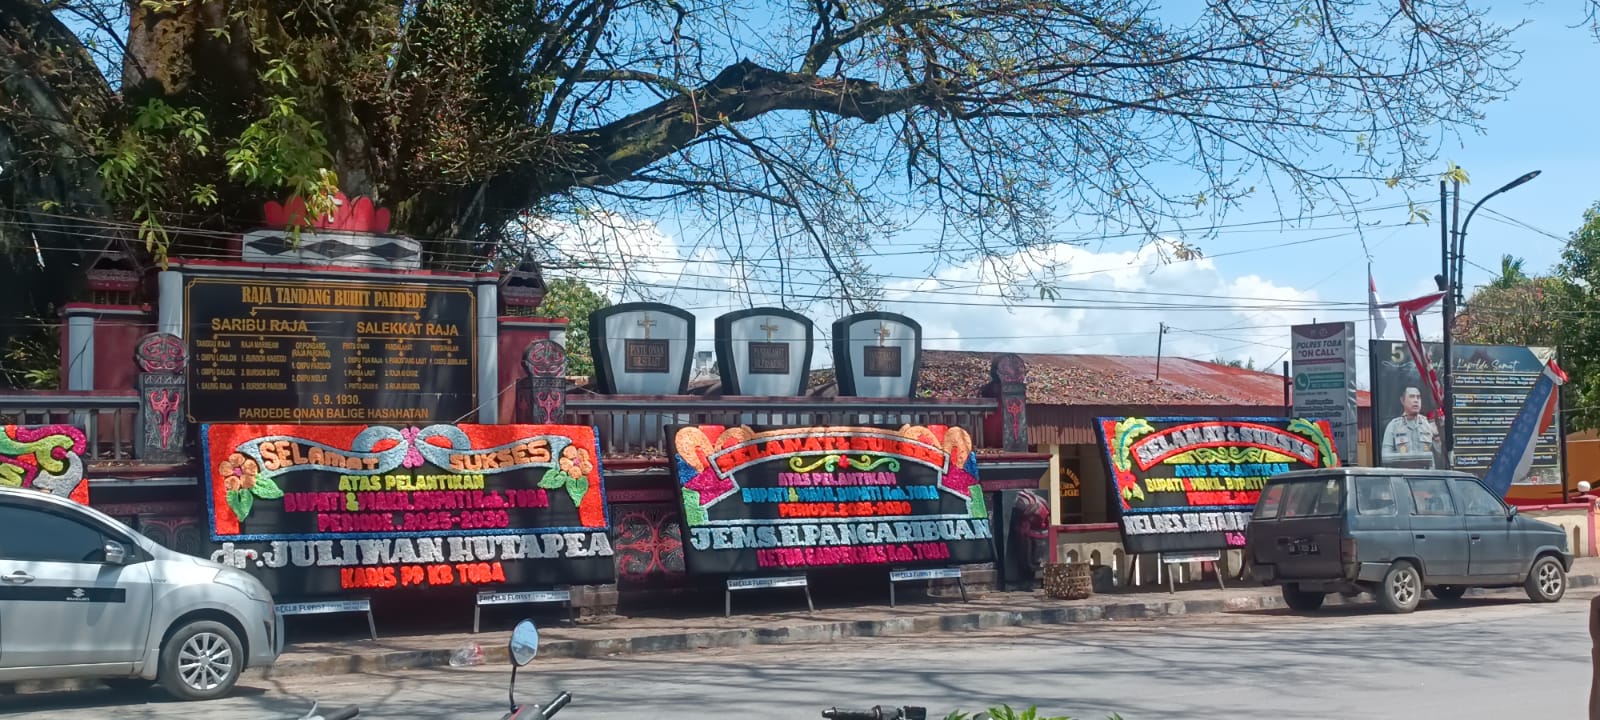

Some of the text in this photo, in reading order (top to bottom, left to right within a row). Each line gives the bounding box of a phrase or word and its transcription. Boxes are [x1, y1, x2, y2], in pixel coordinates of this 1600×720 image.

[242, 286, 272, 304] RAJA
[276, 288, 331, 305] TANDANG
[374, 291, 427, 308] PARDEDE
[211, 318, 308, 332] SARIBU RAJA
[356, 321, 459, 336] SALEKKAT RAJA
[1323, 339, 1342, 348] TOBA
[1391, 342, 1404, 364] 5
[312, 394, 361, 405] 9. 9. 1930.
[239, 408, 429, 419] PARDEDE ONAN BALIGE HASAHATAN
[1136, 425, 1226, 465] SELAMAT
[1240, 426, 1316, 461] SUKSES
[450, 439, 551, 471] SUKSES
[715, 436, 836, 473] SELAMAT
[850, 436, 945, 467] SUKSES
[1175, 463, 1208, 477] ATAS
[339, 474, 485, 491] ATAS PELANTIKAN
[778, 471, 897, 486] ATAS PELANTIKAN
[1145, 477, 1185, 492] BUPATI
[284, 492, 346, 512] BUPATI
[346, 492, 359, 511] &
[742, 487, 789, 503] BUPATI
[447, 532, 614, 562] HUTAPEA
[341, 561, 506, 589] KADIS PP KB TOBA
